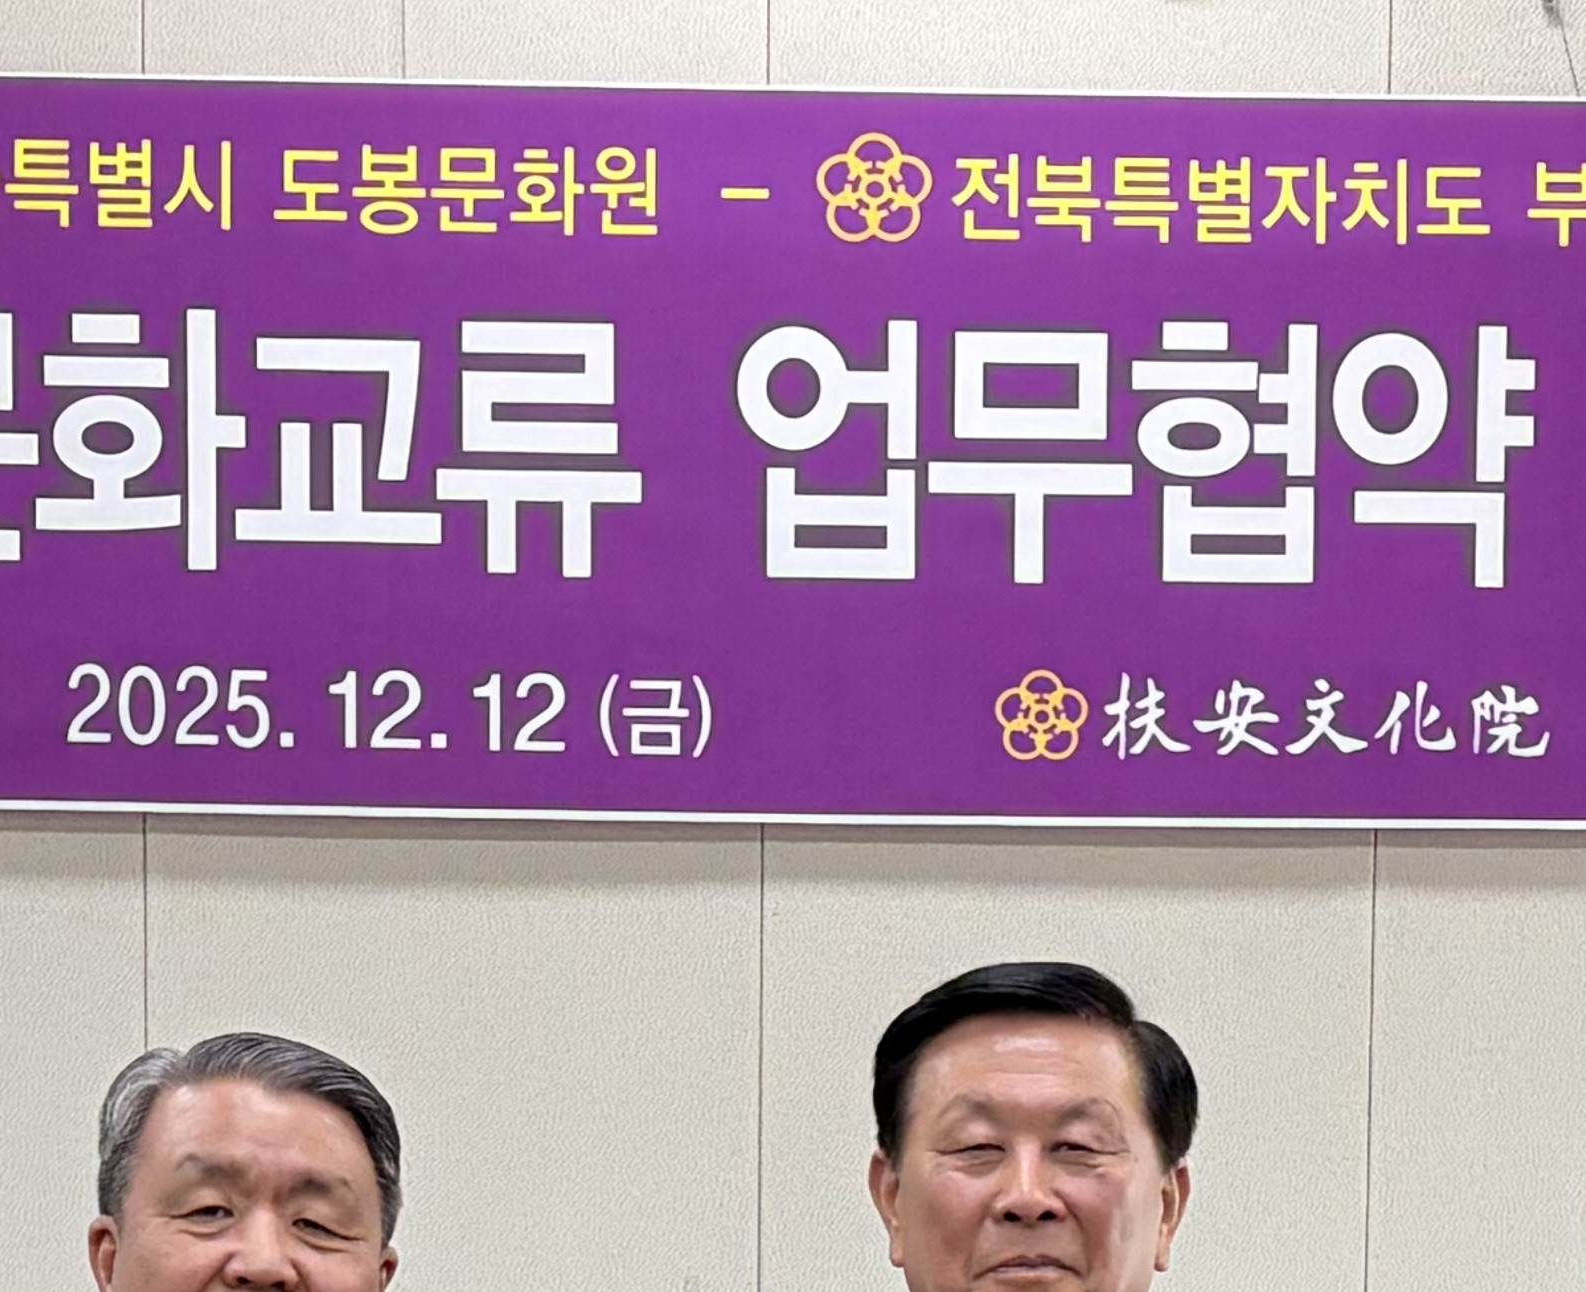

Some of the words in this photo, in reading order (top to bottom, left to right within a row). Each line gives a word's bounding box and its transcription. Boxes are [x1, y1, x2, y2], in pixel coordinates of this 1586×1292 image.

[273, 144, 658, 236] 도봉문화원
[951, 153, 1491, 246] 전북특별자치도
[736, 319, 1536, 589] 업무협약
[65, 662, 295, 750] 2025.
[328, 668, 447, 750] 12.
[473, 672, 567, 752] 12
[598, 674, 713, 758] (금)
[1101, 671, 1551, 761] 扶安文化院
